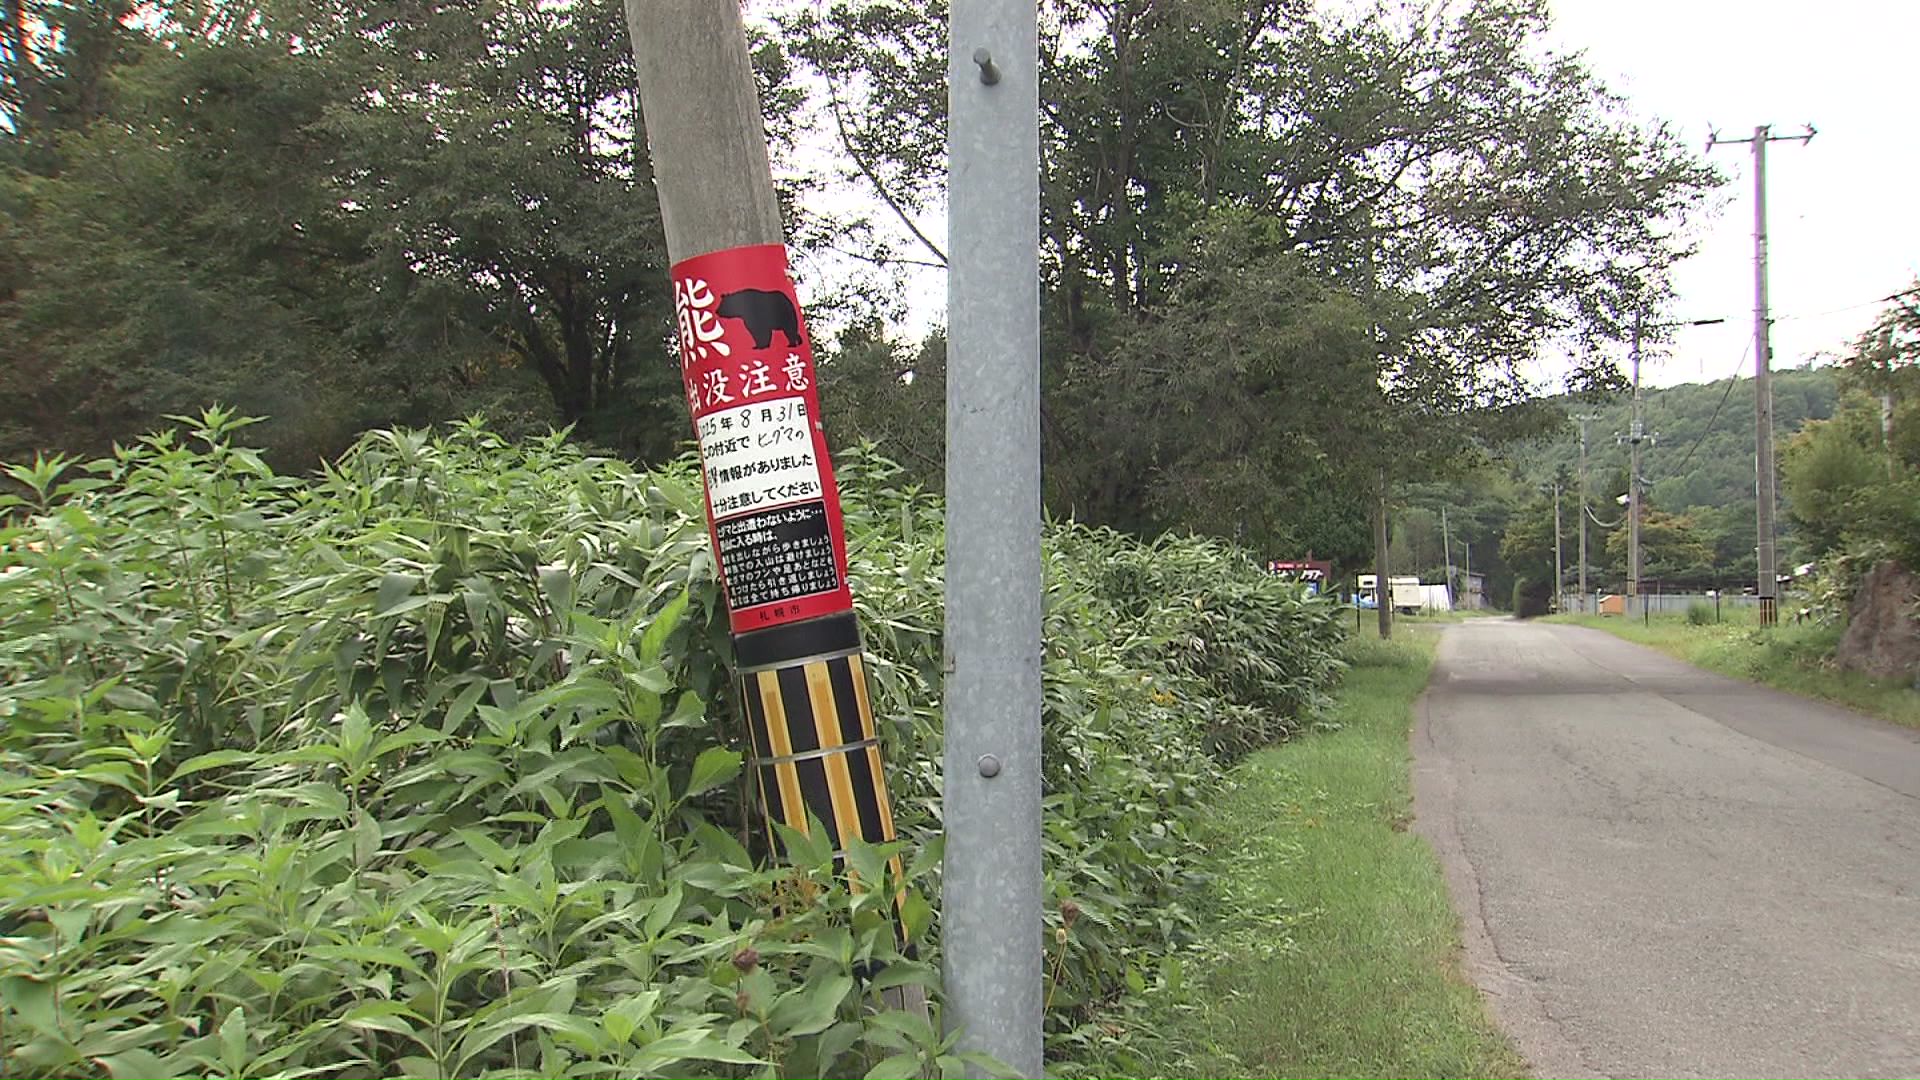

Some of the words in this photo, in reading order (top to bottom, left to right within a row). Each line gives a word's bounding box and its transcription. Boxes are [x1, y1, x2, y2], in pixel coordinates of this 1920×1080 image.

[675, 278, 731, 370] 熊
[689, 353, 809, 411] 出没注意
[713, 481, 820, 515] 十分注意してください
